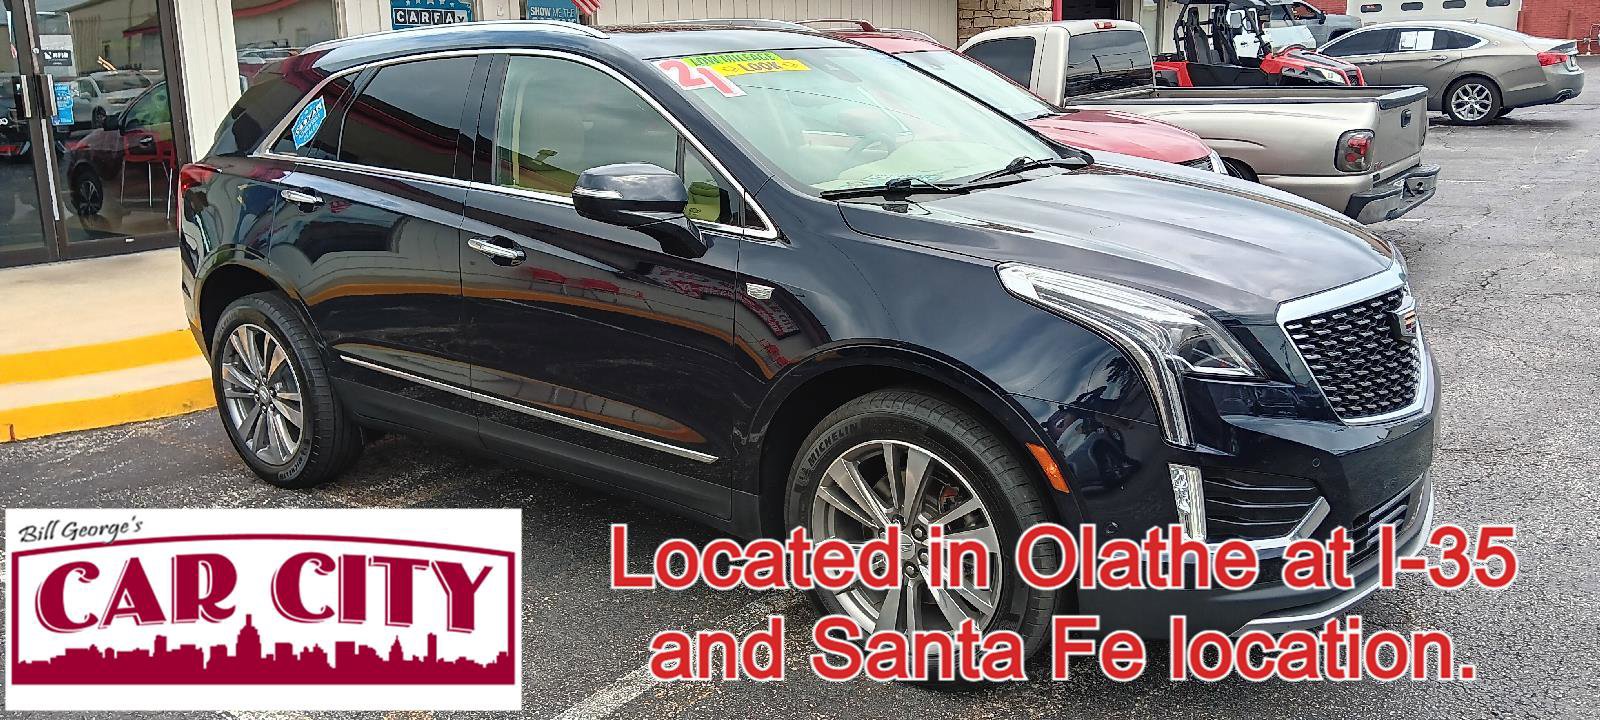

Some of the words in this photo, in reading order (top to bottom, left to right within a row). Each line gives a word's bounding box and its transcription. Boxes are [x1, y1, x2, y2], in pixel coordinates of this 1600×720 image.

[530, 6, 551, 16] SHOW
[690, 56, 717, 66] LOW
[719, 52, 776, 64] MILEAGE
[737, 61, 783, 72] LOOK
[807, 422, 857, 467] MICHELIN
